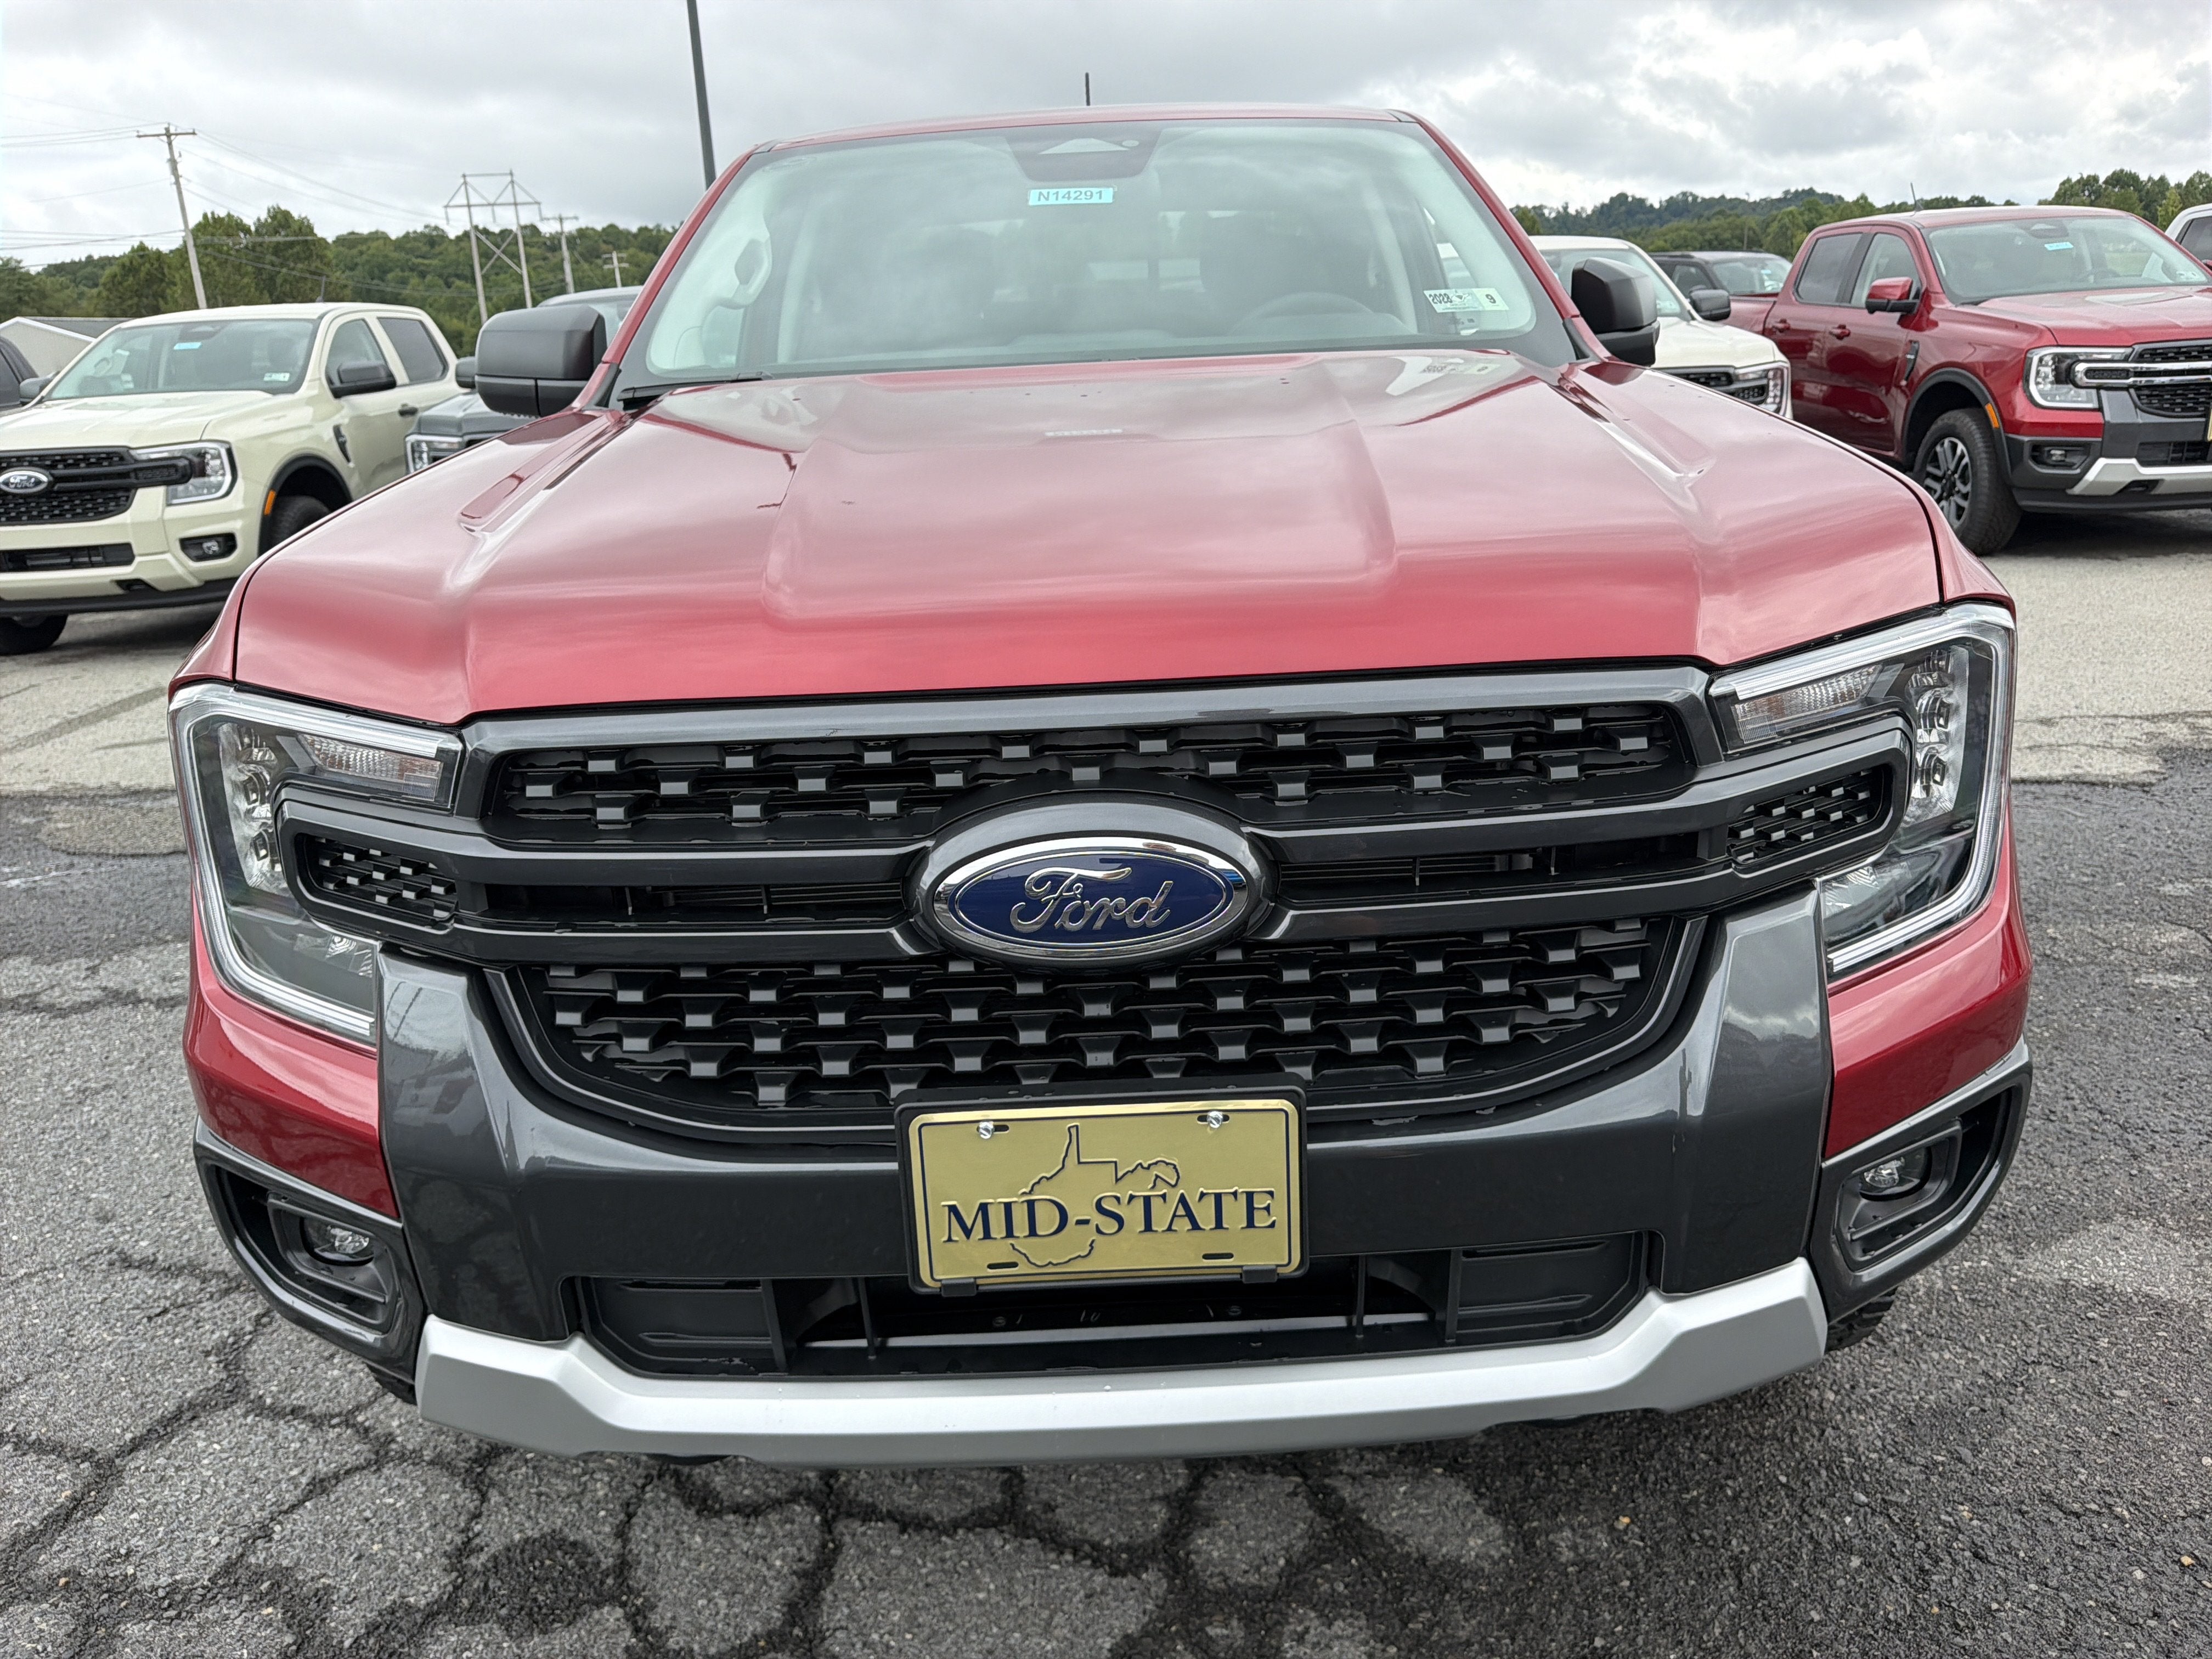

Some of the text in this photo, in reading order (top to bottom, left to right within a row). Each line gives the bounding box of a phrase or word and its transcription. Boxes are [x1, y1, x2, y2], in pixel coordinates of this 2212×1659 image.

[1037, 190, 1104, 201] N14291
[1485, 294, 1497, 303] 9
[9, 475, 35, 488] Ford
[1009, 867, 1173, 932] Ford
[942, 1187, 1277, 1243] MID-STATE
